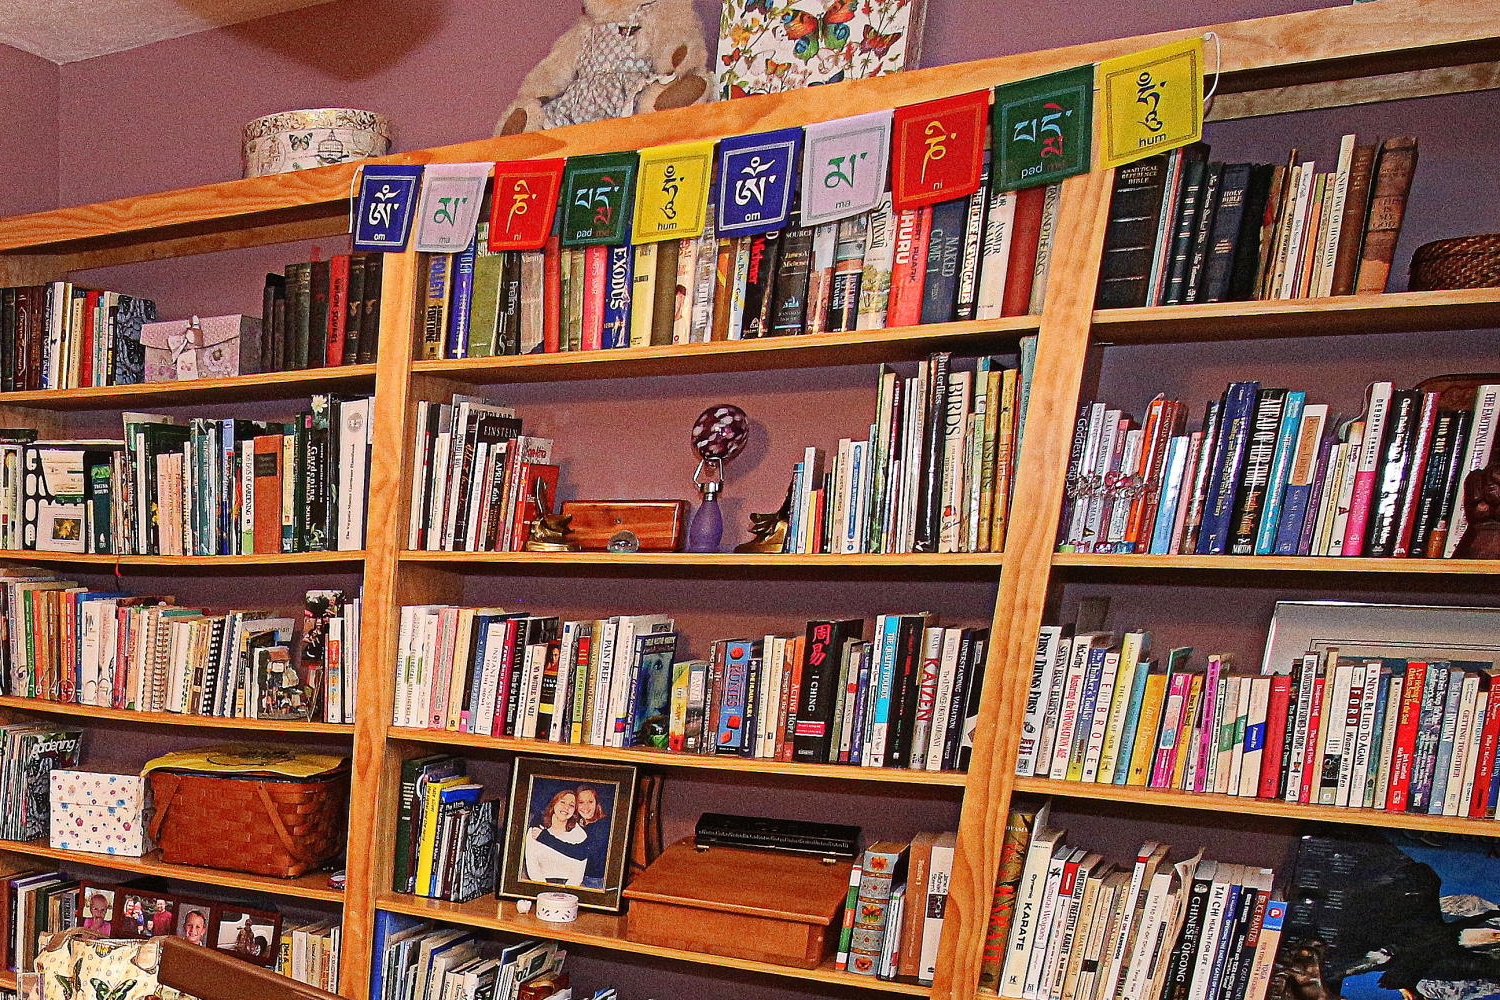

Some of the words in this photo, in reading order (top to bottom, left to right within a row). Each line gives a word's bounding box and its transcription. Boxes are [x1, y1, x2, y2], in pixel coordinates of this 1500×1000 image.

[1138, 132, 1167, 147] hum
[933, 181, 944, 191] ni
[744, 211, 762, 223] om
[835, 200, 852, 210] ma
[373, 232, 387, 241] om
[657, 222, 677, 235] hum
[928, 228, 944, 262] CAME
[941, 236, 960, 277] NAKED
[1326, 227, 1338, 269] HINDUISM
[748, 238, 765, 284] Michener
[610, 246, 628, 310] EXODUS
[935, 356, 949, 405] Butterflies
[945, 381, 964, 436] BIRDS
[1484, 392, 1497, 408] THE
[1256, 398, 1283, 430] AHEAD
[484, 425, 518, 438] EINSTEIN
[1072, 417, 1088, 458] Goddess
[1253, 431, 1276, 443] OF
[1474, 408, 1494, 449] EMOTIONAL
[1249, 445, 1273, 464] HER
[310, 446, 319, 501] Gardening
[493, 461, 503, 484] APRIL
[1245, 465, 1270, 487] TIME
[603, 639, 612, 659] PAIN
[887, 632, 895, 644] THE
[1038, 632, 1053, 657] FIRST
[883, 645, 894, 670] QUALITY
[954, 639, 970, 692] UNDERSTANDING
[1055, 645, 1069, 668] SEVEN
[1072, 643, 1088, 669] McCarthy
[881, 671, 891, 699] TOOLBOX
[1032, 659, 1049, 688] THINGS
[1052, 669, 1064, 690] BASIC
[1086, 662, 1102, 695] Thinker's
[1102, 658, 1117, 688] DIE
[789, 683, 799, 712] ACTIVE
[807, 682, 819, 712] CHING
[917, 657, 940, 722] KAIZEN
[1065, 674, 1082, 700] Mastering
[1117, 685, 1127, 699] THE
[1365, 677, 1377, 700] NEVER
[948, 695, 961, 729] VARIATION
[1026, 691, 1042, 716] FIRST
[1067, 700, 1076, 710] the
[1081, 696, 1096, 721] Toolkit
[1113, 700, 1124, 723] POWER
[1347, 689, 1361, 725] FORD
[1364, 702, 1375, 711] BE
[1059, 709, 1076, 747] INFORMATION
[1110, 725, 1119, 733] OF
[1360, 712, 1372, 730] LIED
[1459, 709, 1472, 739] GETTING
[1087, 707, 1108, 764] BROKE
[1108, 735, 1117, 750] NOW
[1343, 731, 1356, 756] Women
[1360, 731, 1370, 741] TO
[1056, 748, 1068, 759] AGE
[1341, 758, 1350, 772] with
[1356, 742, 1368, 766] AGAIN
[1453, 740, 1467, 779] TOGETHER
[1339, 774, 1348, 788] Men
[1027, 873, 1038, 899] Dynamic
[1043, 881, 1058, 909] Samurai
[1072, 869, 1088, 900] AMERICAN
[1214, 886, 1226, 899] TAI
[1065, 901, 1081, 931] FREESTYLE
[1210, 901, 1223, 917] CHI
[1255, 895, 1267, 914] BRUCE
[1015, 902, 1033, 951] KARATE
[1038, 910, 1053, 941] Weapons
[1183, 897, 1201, 940] CHINESE
[1205, 919, 1217, 940] HEALTH
[1247, 915, 1262, 943] FRANTZIS
[1060, 933, 1073, 954] KARATE
[1203, 941, 1213, 952] FOR
[1175, 943, 1192, 982] QIGONG
[1201, 953, 1210, 966] LIFE
[1259, 964, 1270, 981] YOGA
